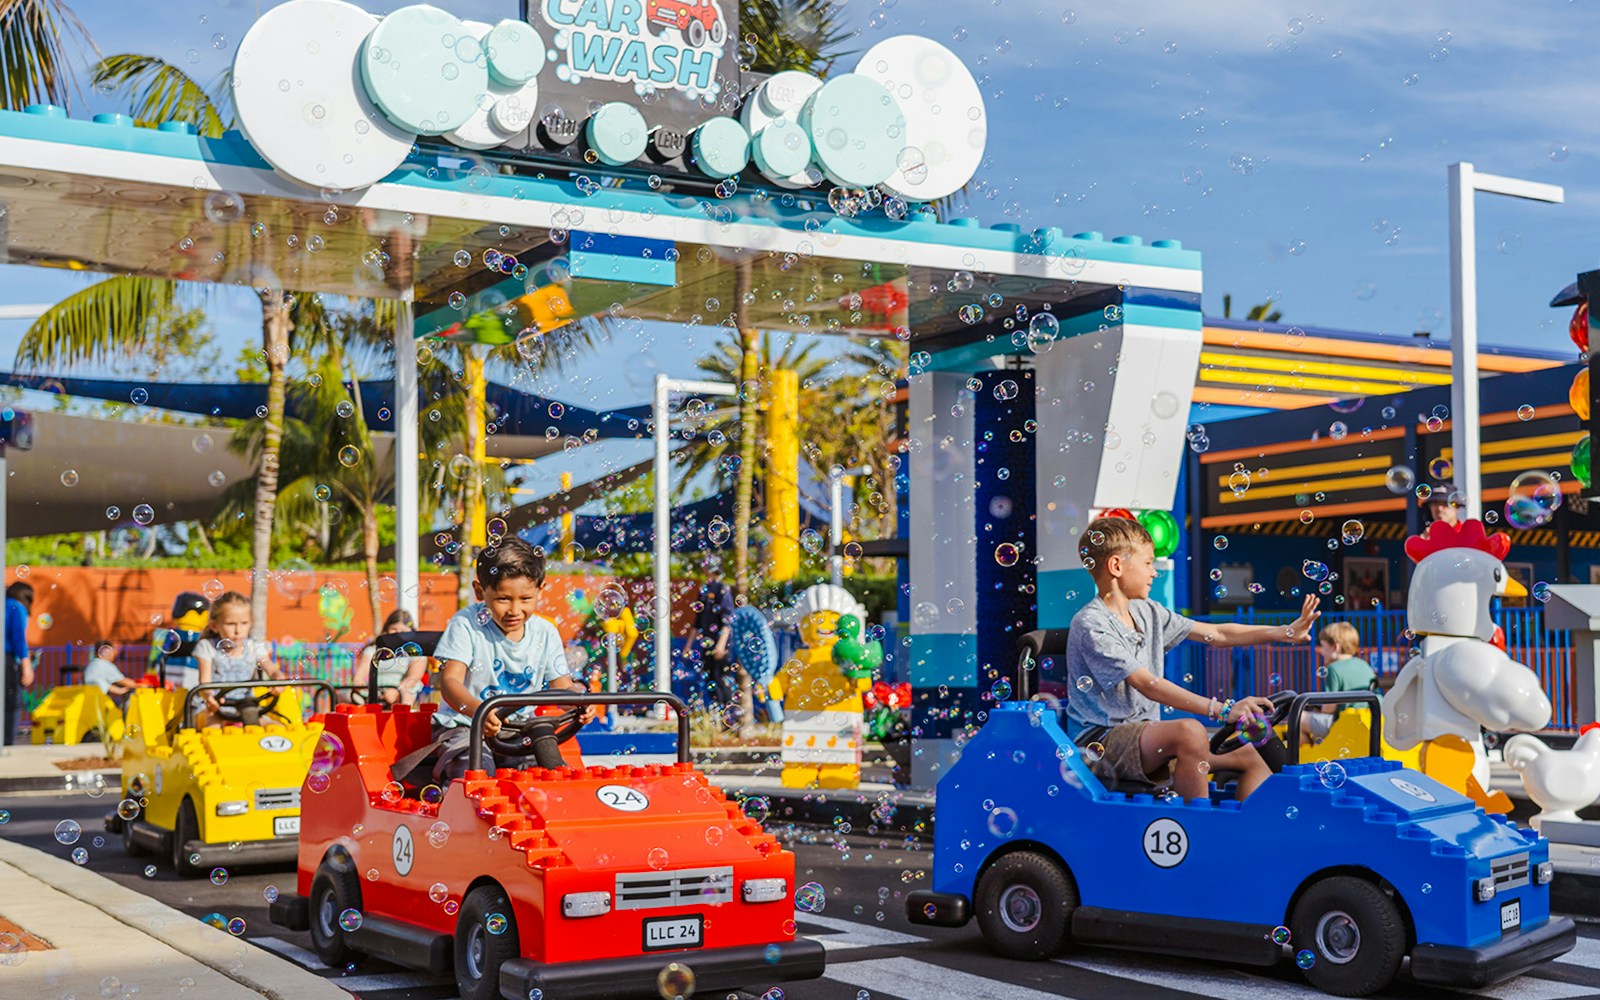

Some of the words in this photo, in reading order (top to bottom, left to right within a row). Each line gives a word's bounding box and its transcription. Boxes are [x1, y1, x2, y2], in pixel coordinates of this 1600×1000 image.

[547, 0, 643, 36] CAR
[571, 31, 714, 90] WASH
[604, 791, 643, 806] 24
[278, 820, 297, 831] LLC
[395, 836, 412, 864] 24
[1149, 830, 1183, 856] 18
[1502, 910, 1512, 924] LLC
[650, 926, 676, 941] LLC
[679, 925, 697, 939] 24
